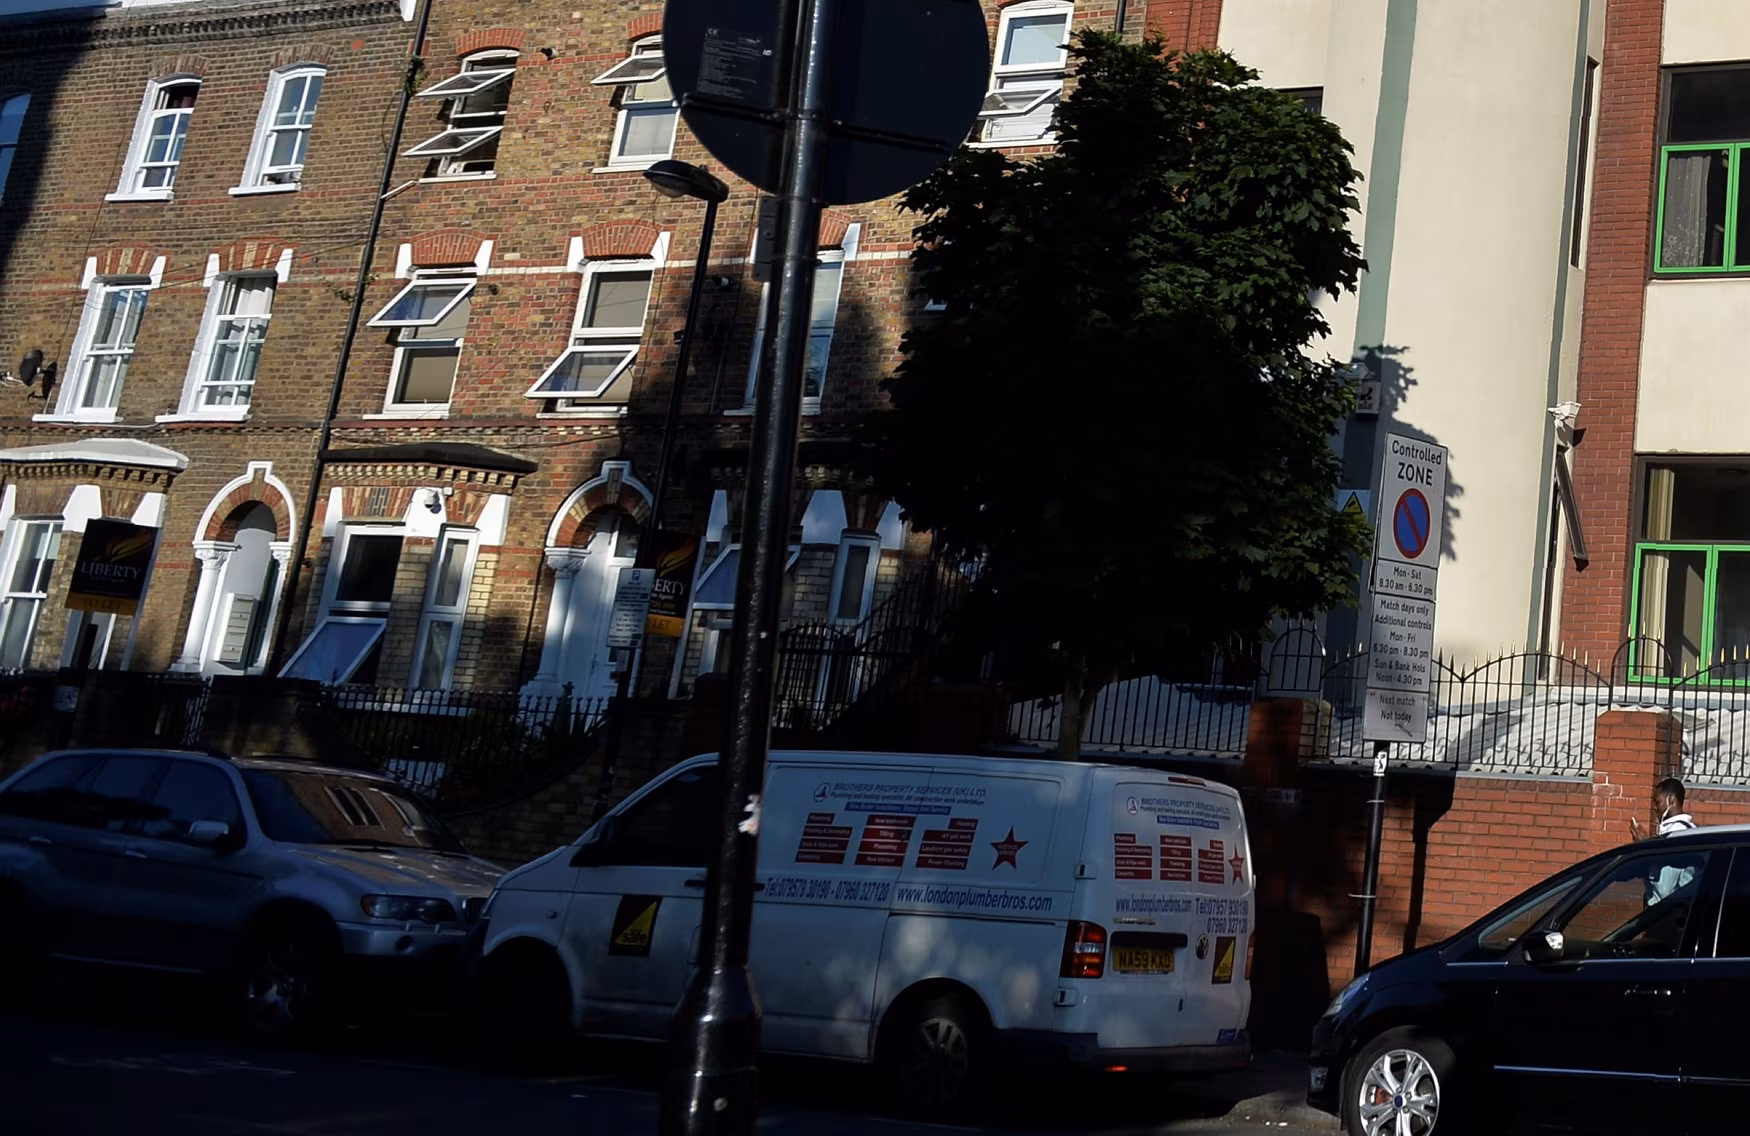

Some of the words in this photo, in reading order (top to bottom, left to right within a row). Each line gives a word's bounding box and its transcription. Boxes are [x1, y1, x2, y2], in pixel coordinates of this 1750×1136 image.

[1392, 440, 1442, 465] Controlled
[1397, 461, 1433, 486] ZONE
[81, 561, 142, 579] LIBERTY
[1394, 566, 1406, 577] Mon
[1410, 569, 1422, 580] Sat
[652, 578, 688, 596] ERTY
[1379, 578, 1394, 589] 8.30
[1395, 582, 1404, 591] am
[1408, 582, 1422, 594] 6.30
[1424, 587, 1433, 596] pm
[1380, 599, 1400, 610] Match
[1401, 602, 1415, 614] days
[1416, 606, 1429, 616] only
[1374, 614, 1406, 627] Additional
[1407, 620, 1432, 631] controls
[1390, 631, 1403, 642] Mon
[1408, 632, 1416, 644] Fri
[1374, 643, 1388, 654] 6.30
[1403, 646, 1418, 657] 8.30
[1374, 658, 1387, 668] Sun
[1395, 661, 1410, 671] Bank
[1412, 663, 1426, 673] Hols
[1376, 672, 1392, 682] Noon
[1396, 674, 1412, 684] 4.30
[1412, 677, 1422, 685] pm
[1380, 695, 1394, 704] Next
[1396, 696, 1415, 706] match
[1381, 711, 1392, 720] Not
[1394, 712, 1412, 723] today
[833, 782, 874, 792] BROTHERS
[875, 785, 914, 794] PROPERTY
[914, 786, 952, 796] SERVICES
[835, 880, 860, 901] 07960
[860, 882, 890, 903] 327120
[897, 884, 1052, 912] www.londonplumberbros.com
[1115, 894, 1191, 916] www.londonplumberbros.com
[622, 930, 648, 944] safe
[1118, 951, 1149, 968] NA59
